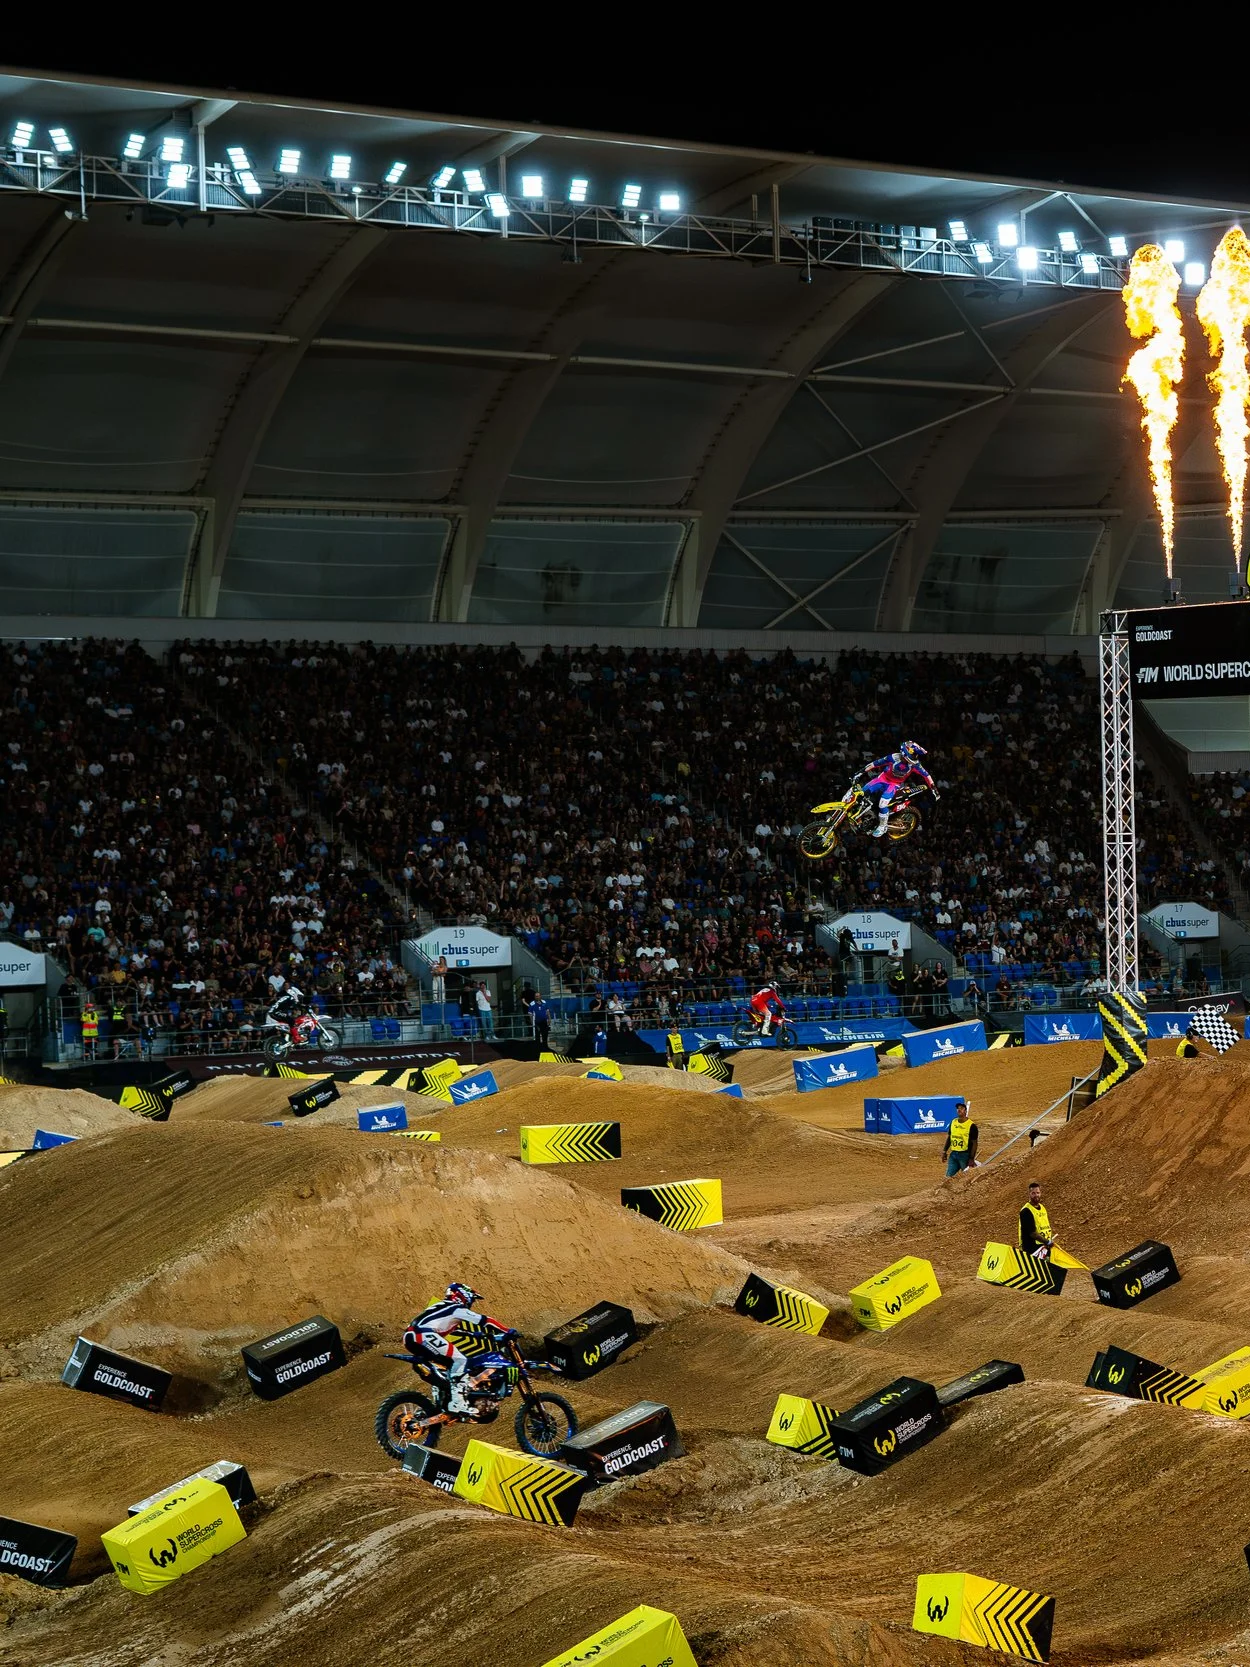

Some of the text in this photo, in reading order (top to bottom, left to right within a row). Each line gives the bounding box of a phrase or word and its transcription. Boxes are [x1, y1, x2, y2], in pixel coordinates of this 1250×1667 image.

[1135, 630, 1172, 642] GOLDCOAST
[1136, 666, 1159, 683] FIM
[1163, 662, 1204, 682] WORLD
[1174, 904, 1184, 912] 17
[862, 915, 872, 923] 18
[1165, 917, 1209, 928] cbus super
[453, 929, 465, 938] 19
[851, 928, 901, 942] cbus super
[441, 944, 500, 957] cbus super
[825, 1033, 885, 1041] MICHELIN
[932, 1047, 965, 1058] MICHELIN
[826, 1072, 858, 1083] MICHELIN
[371, 1121, 397, 1130] MICHELIN
[914, 1121, 945, 1130] MICHELIN
[98, 1363, 128, 1379] EXPERIENCE
[274, 1358, 302, 1374] EXPERIENCE
[276, 1352, 332, 1384] GOLDCOAST
[93, 1369, 153, 1400] GOLDCOAST
[895, 1417, 915, 1434] WORLD
[897, 1413, 932, 1439] SUPERCROSS
[602, 1443, 633, 1462] EXPERIENCE
[604, 1434, 666, 1475] GOLDCOAST
[176, 1524, 201, 1542] WORLD
[179, 1518, 224, 1549] SUPERCROSS
[181, 1530, 217, 1553] CHAMPIONSHIP
